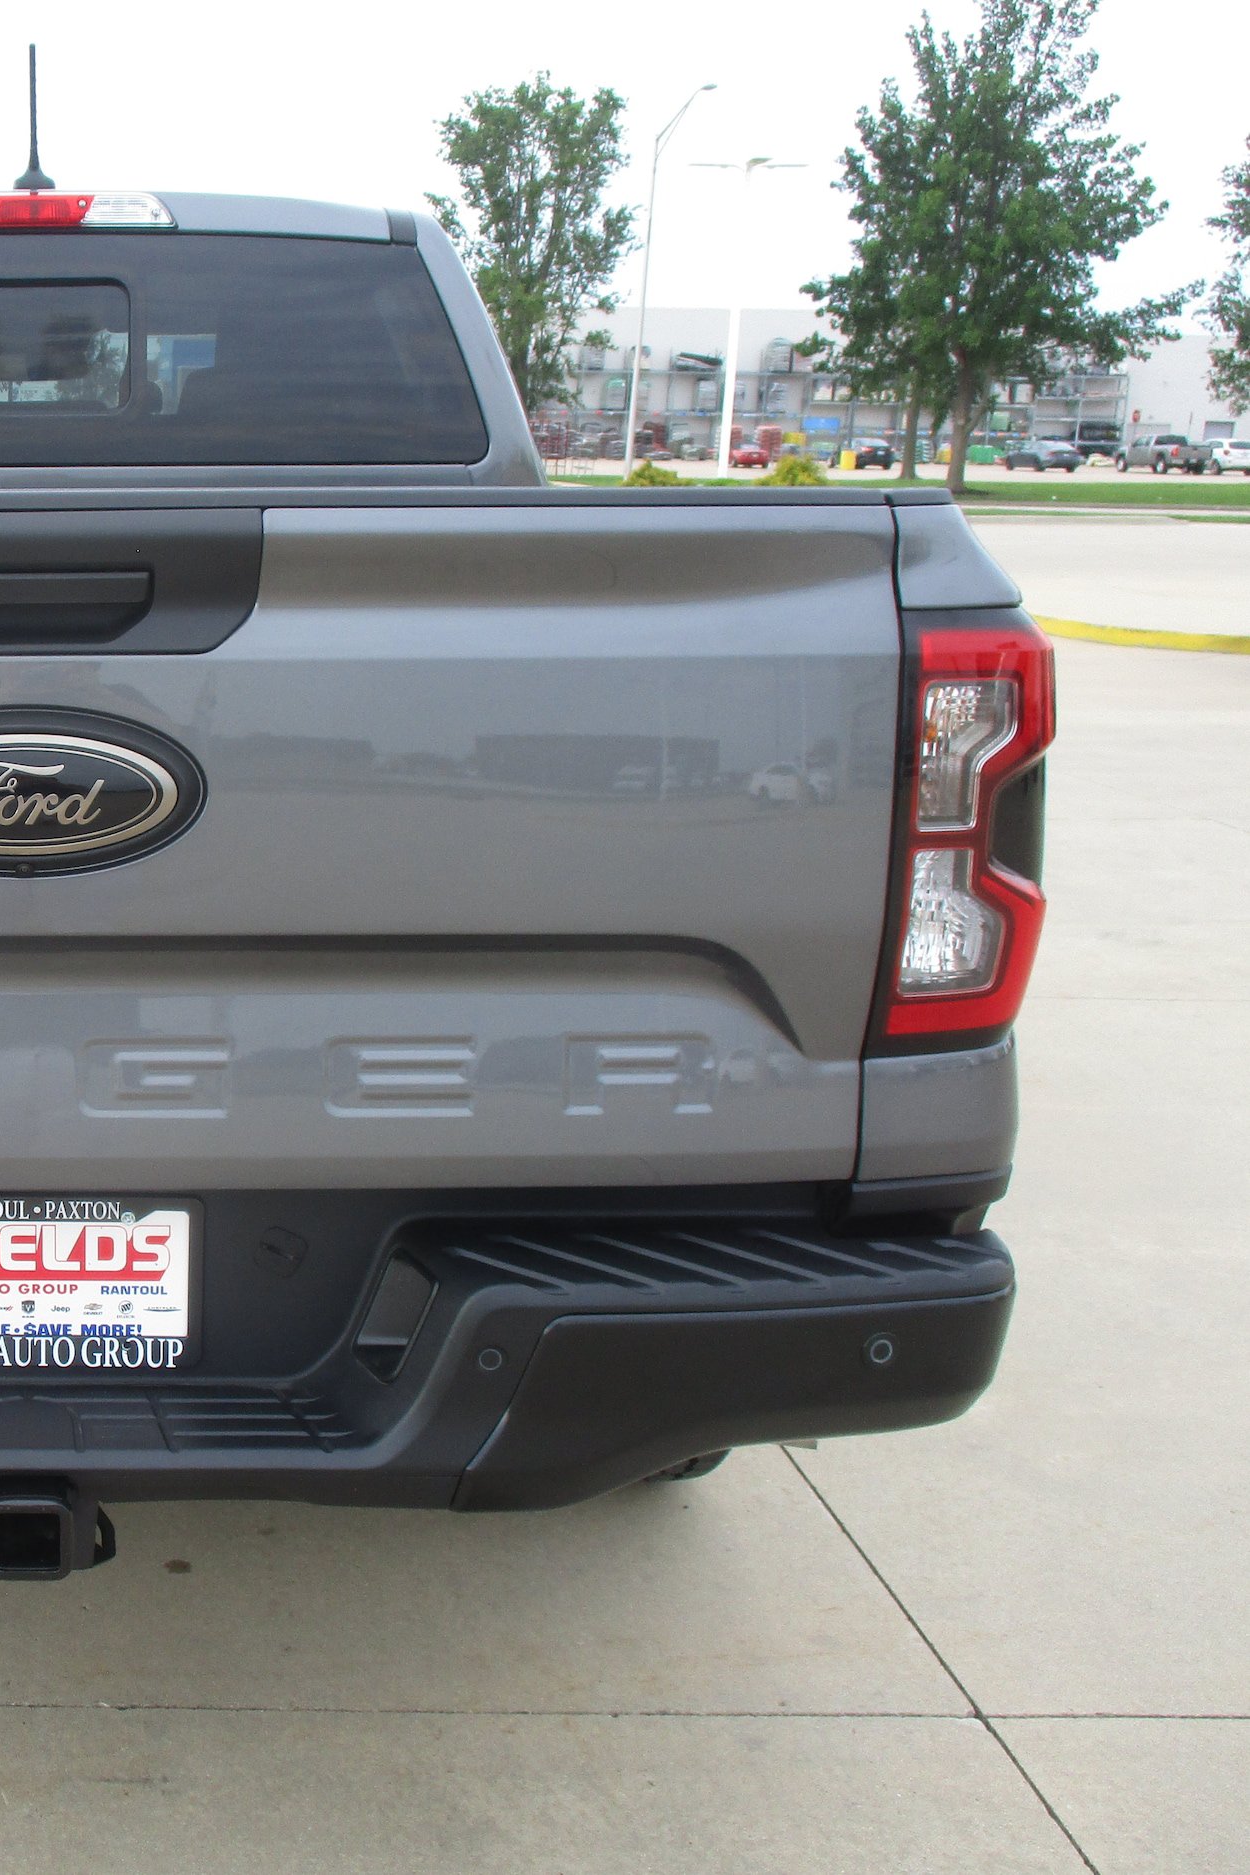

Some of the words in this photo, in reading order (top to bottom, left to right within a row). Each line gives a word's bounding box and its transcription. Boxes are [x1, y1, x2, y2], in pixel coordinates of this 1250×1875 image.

[44, 1201, 121, 1221] PAXTON
[18, 1283, 79, 1295] GROUP
[100, 1285, 168, 1296] RANTOUL
[50, 1305, 71, 1313] Jeep
[81, 1324, 142, 1338] MORE!
[81, 1337, 184, 1369] GROUP
